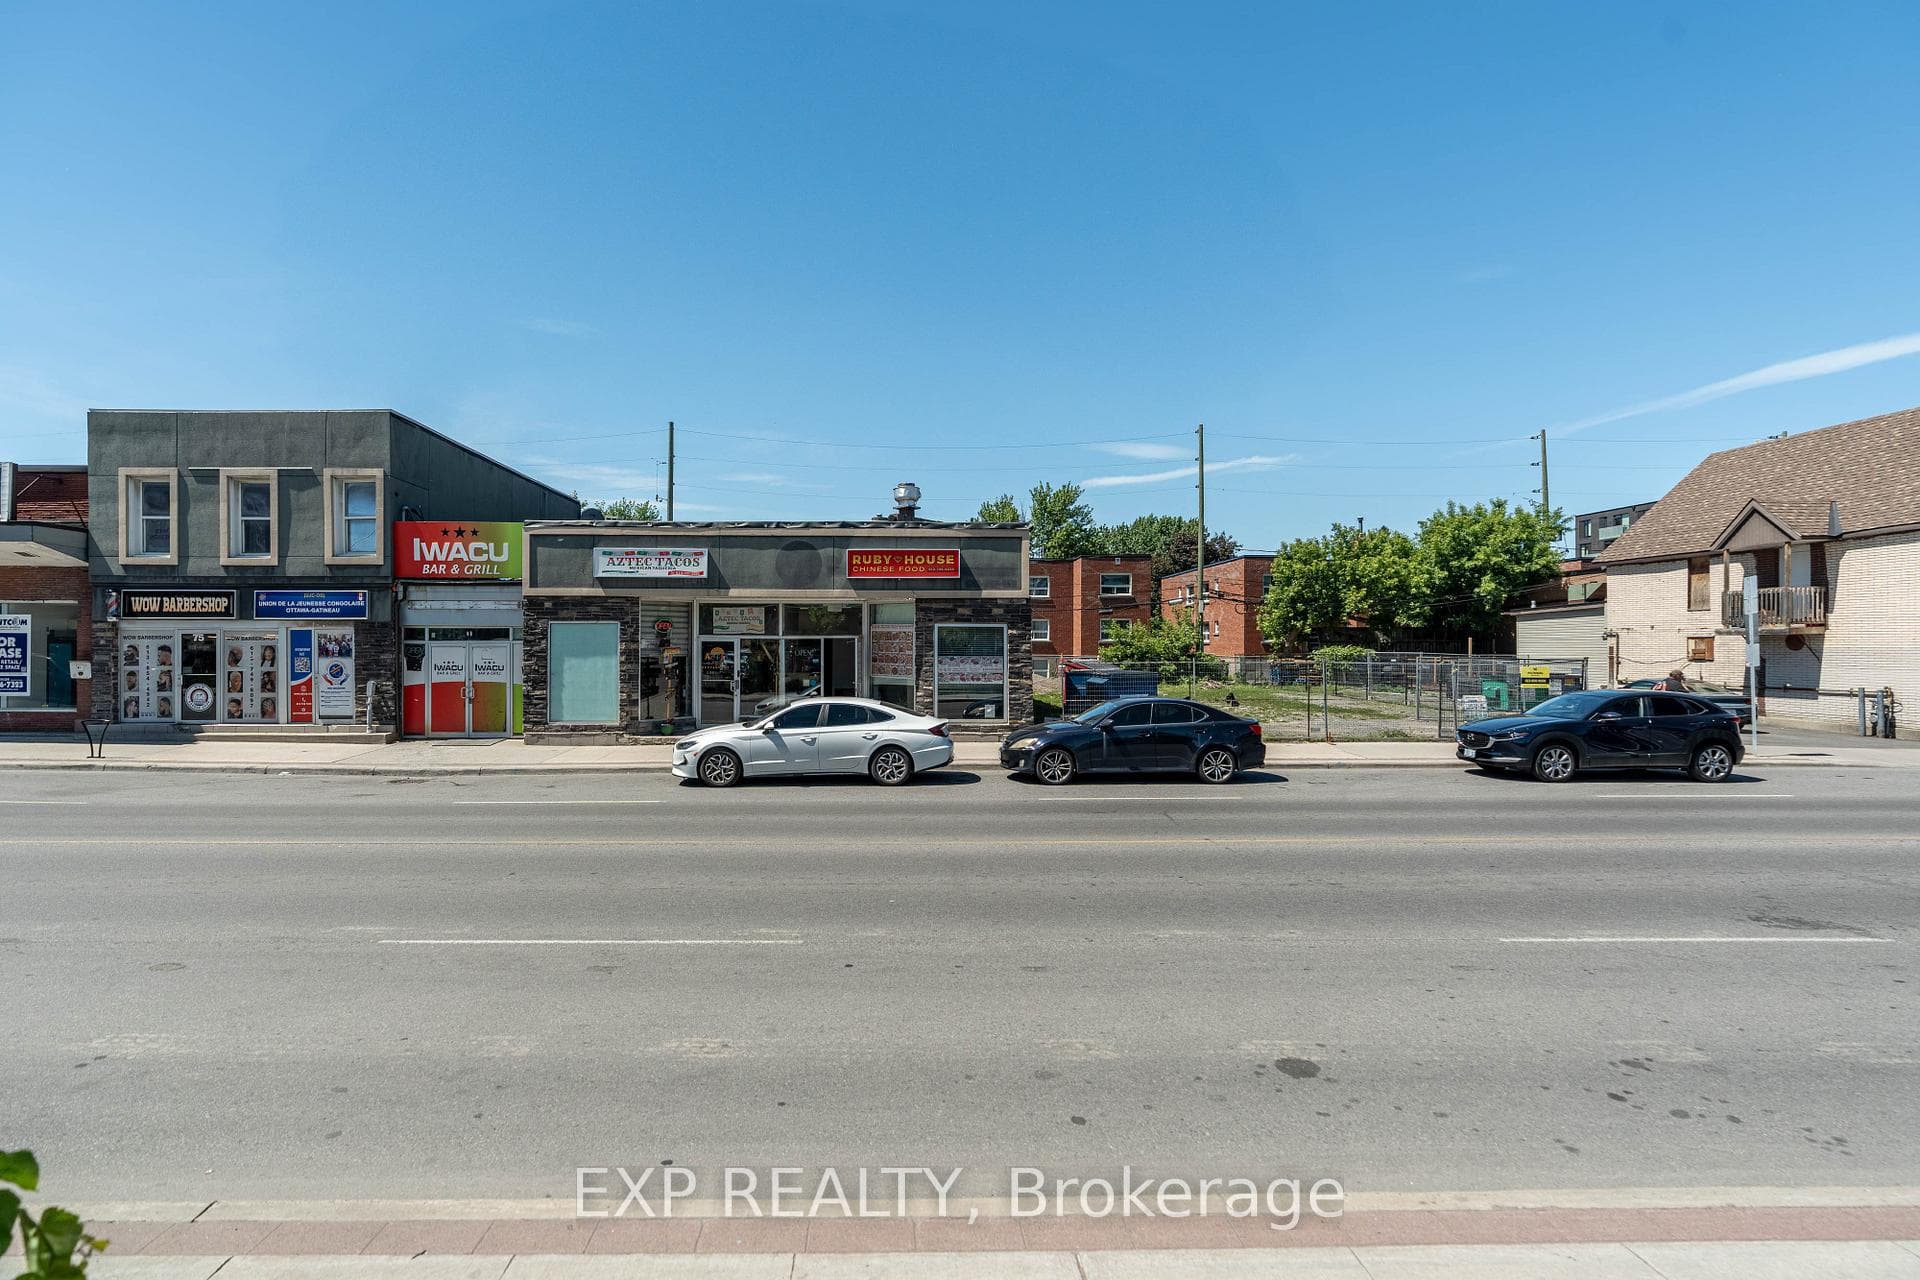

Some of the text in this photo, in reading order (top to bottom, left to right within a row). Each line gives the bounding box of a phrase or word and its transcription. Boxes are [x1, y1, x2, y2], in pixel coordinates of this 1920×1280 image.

[413, 537, 509, 562] IWACU
[606, 557, 701, 567] AZTEC TACOS
[852, 554, 955, 565] RUBY HOUSE
[422, 564, 501, 575] BAR & GRILL
[130, 596, 229, 613] WOW BARBERSHOP
[192, 633, 206, 642] 75
[433, 663, 464, 672] IWACU
[474, 663, 505, 672] IWACU
